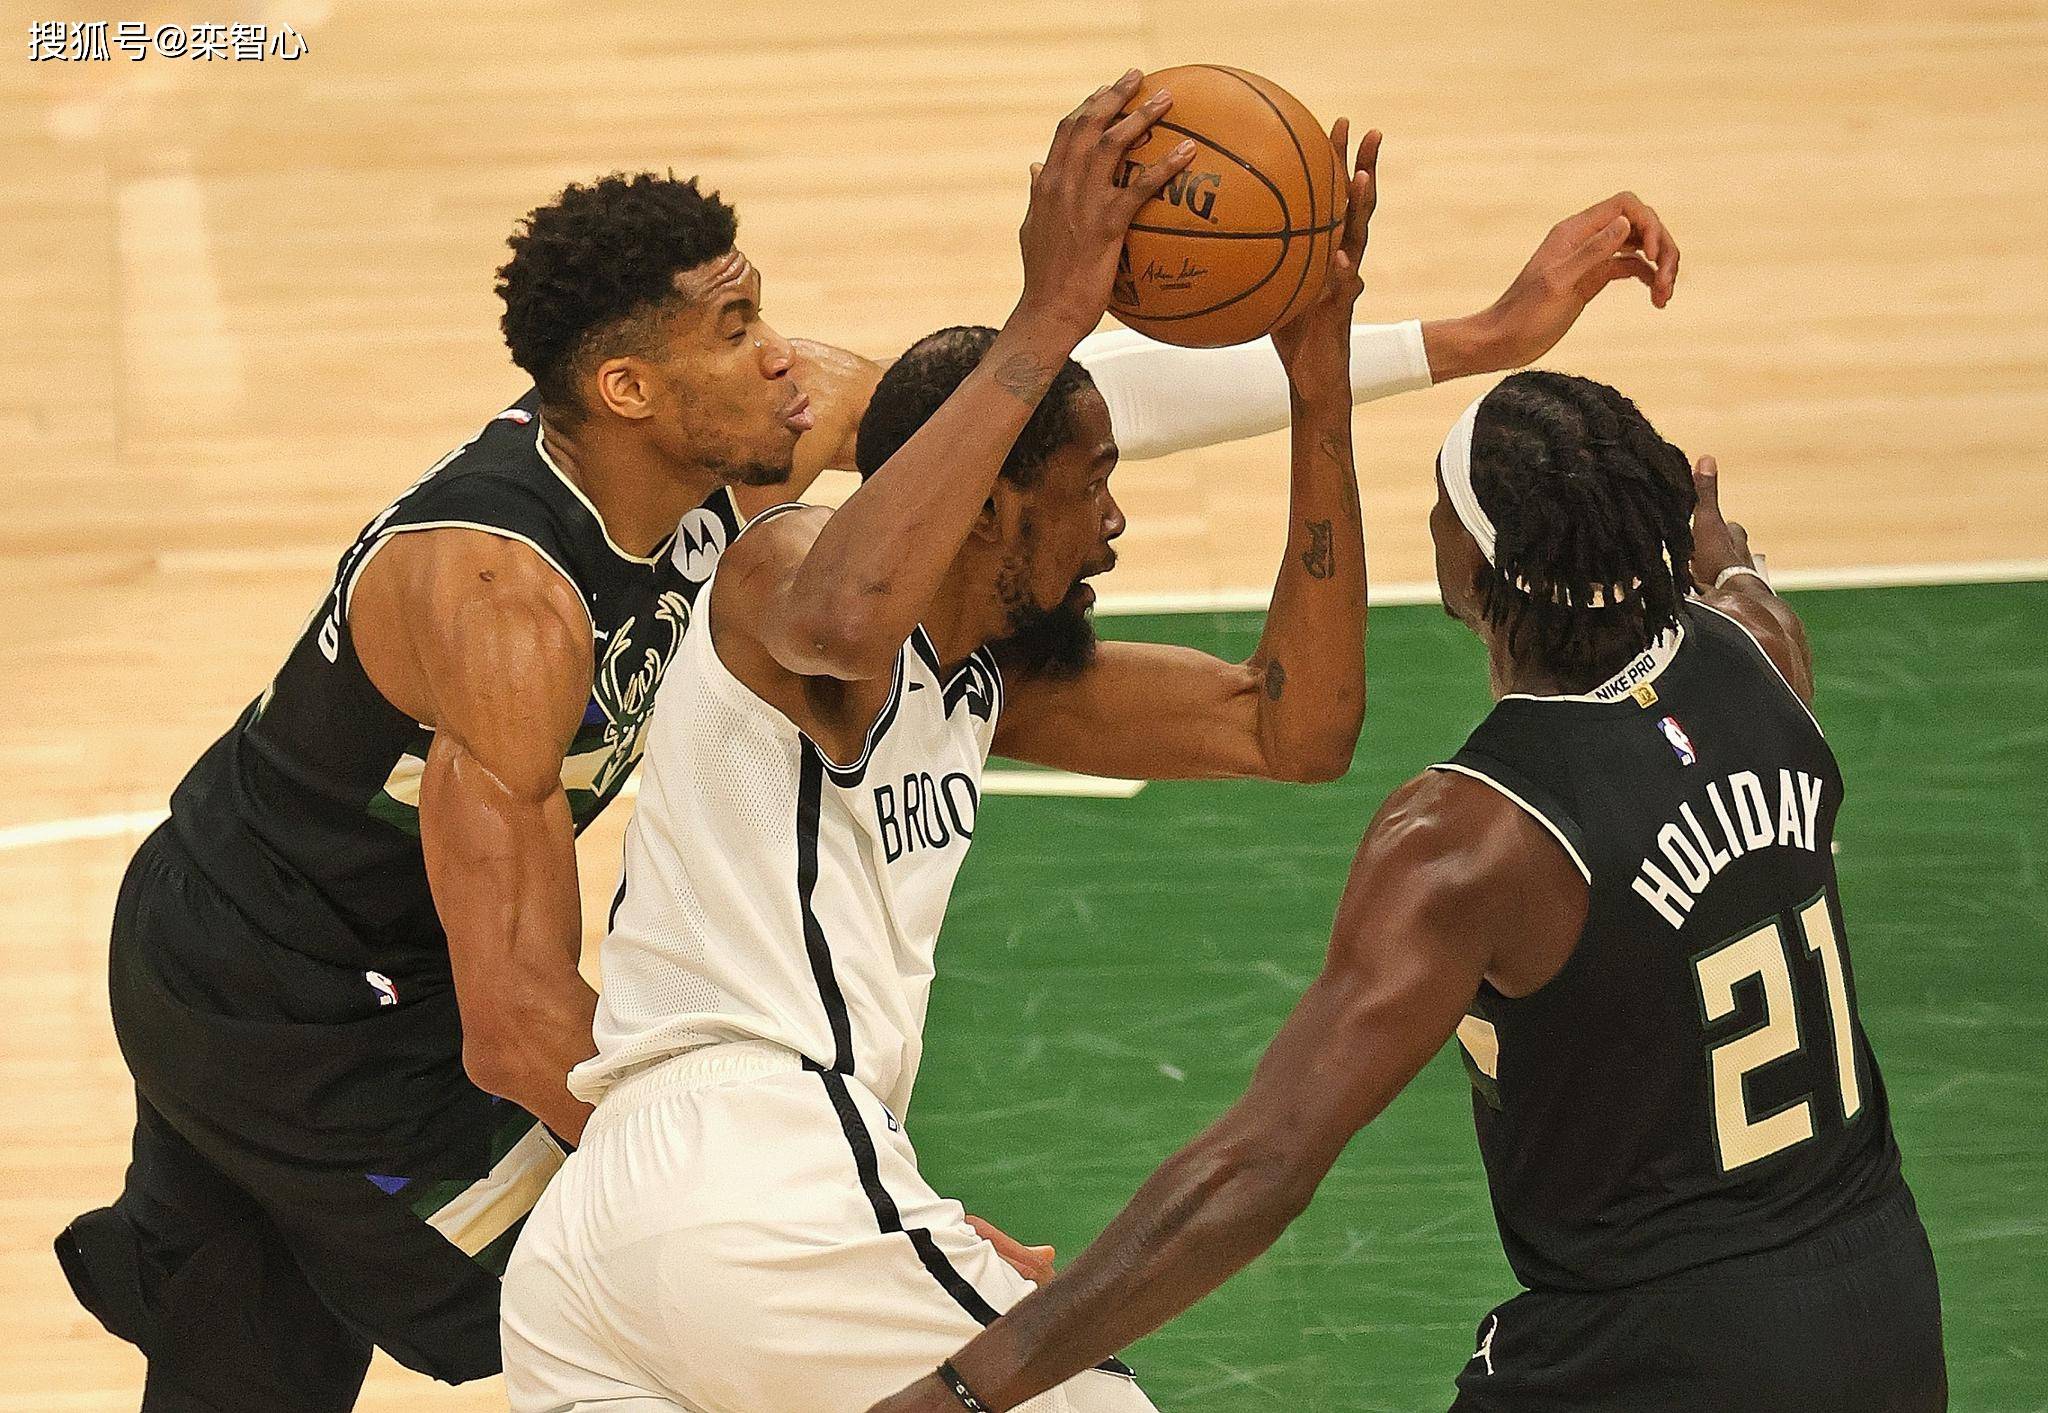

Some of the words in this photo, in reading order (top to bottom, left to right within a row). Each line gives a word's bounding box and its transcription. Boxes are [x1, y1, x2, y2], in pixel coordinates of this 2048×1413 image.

[1595, 675, 1631, 700] NIKE
[1627, 654, 1656, 684] PRO
[1631, 768, 1824, 931] HOLIDAY
[1692, 888, 1862, 1174] 21
